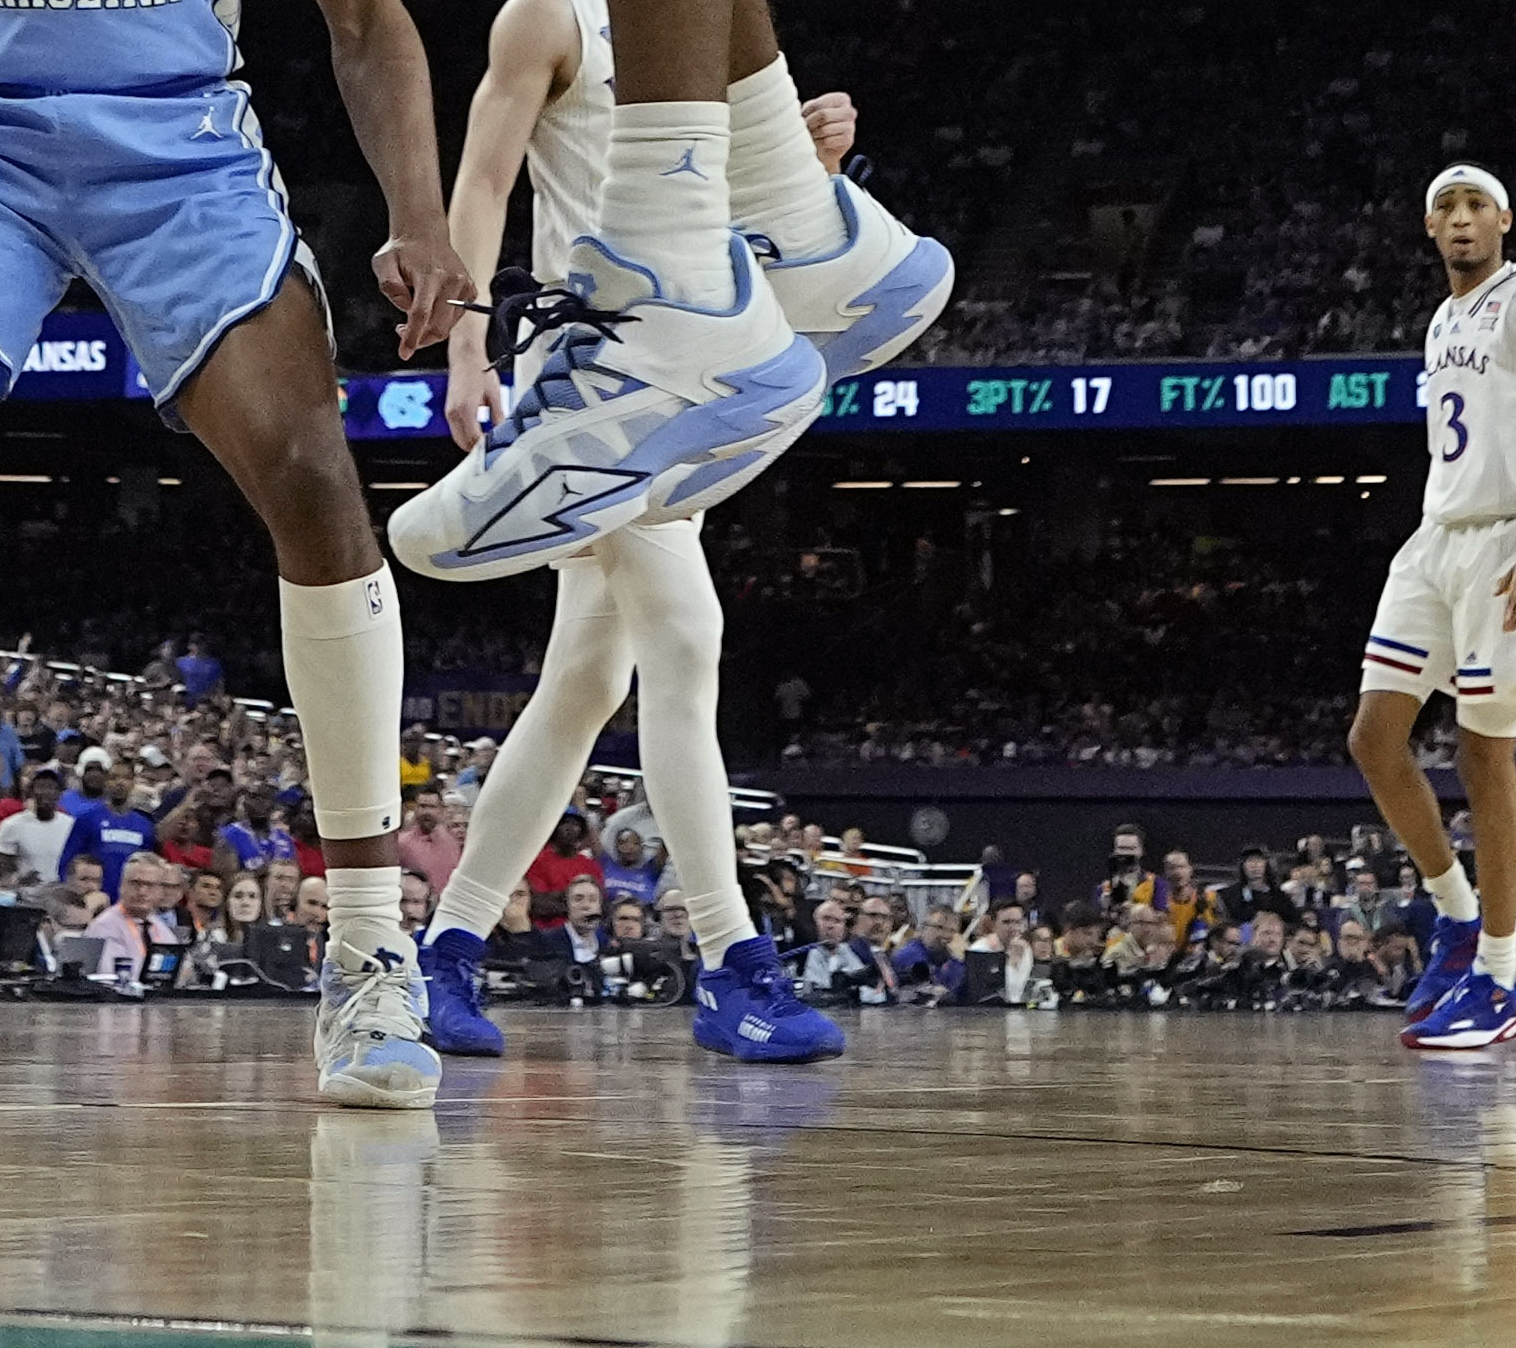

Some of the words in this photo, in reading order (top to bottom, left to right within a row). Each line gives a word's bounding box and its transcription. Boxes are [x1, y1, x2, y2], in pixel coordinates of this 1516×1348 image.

[22, 340, 106, 372] ANSAS
[873, 380, 919, 417] 24
[967, 378, 1052, 414] 3PT%
[1071, 378, 1112, 414] 17
[1160, 376, 1224, 412] FT%
[1233, 374, 1296, 410] 100
[1328, 372, 1389, 408] AST
[1441, 391, 1468, 462] 3
